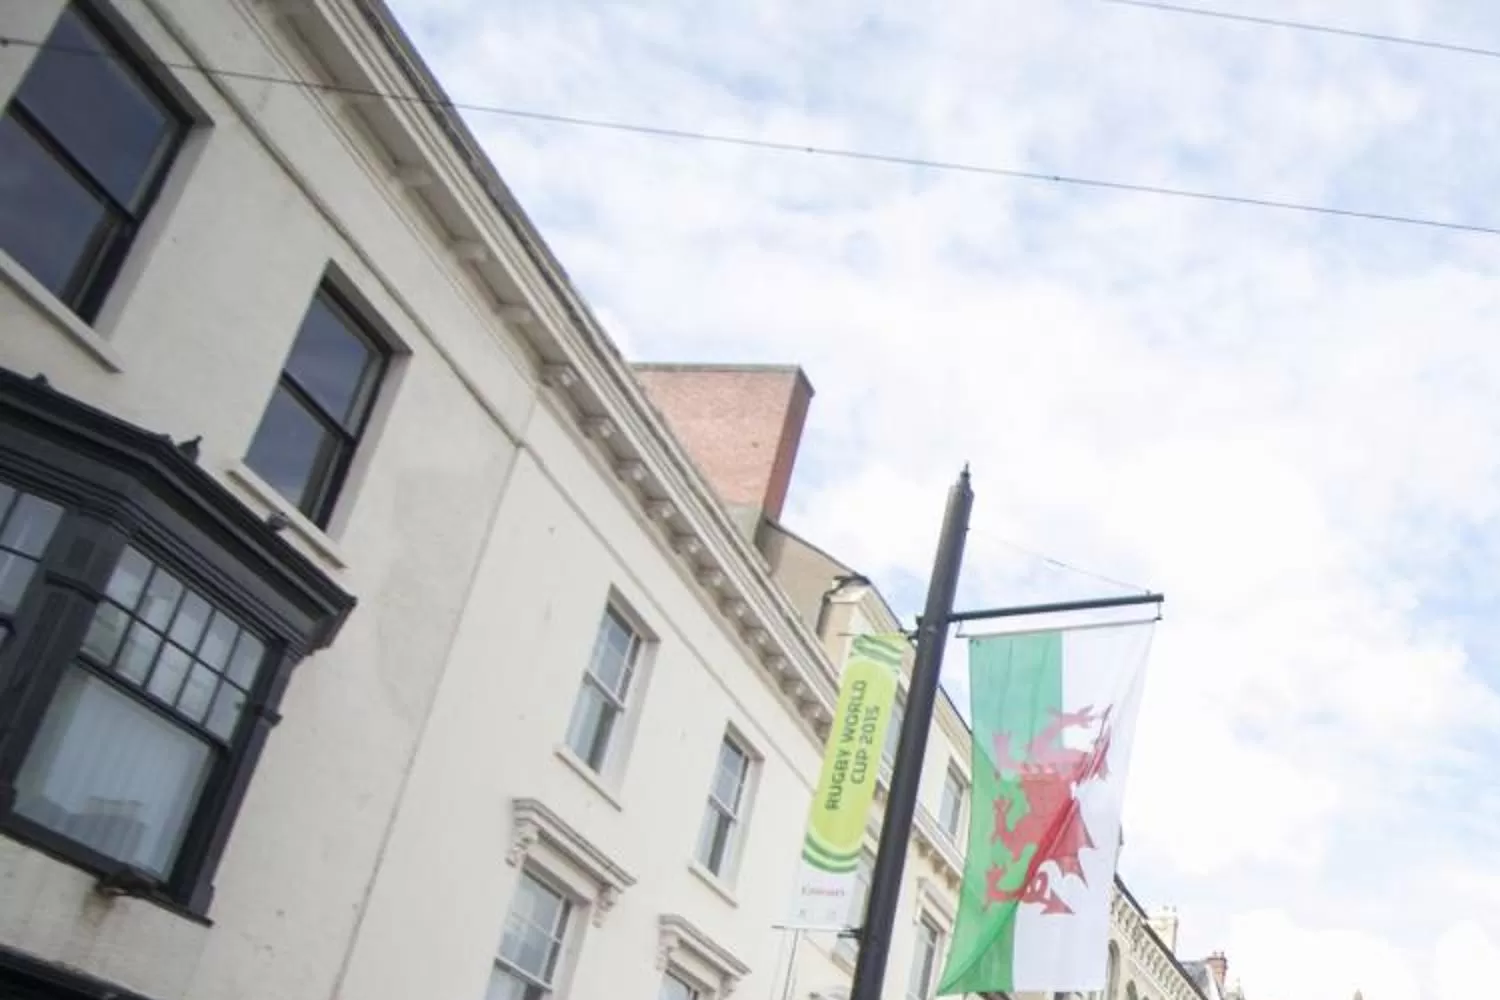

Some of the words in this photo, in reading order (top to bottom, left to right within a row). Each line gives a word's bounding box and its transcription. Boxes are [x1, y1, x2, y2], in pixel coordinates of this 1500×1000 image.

[859, 704, 881, 745] 2015
[825, 748, 851, 811] RUGBY
[842, 680, 868, 745] WORLD
[850, 750, 870, 785] CUP
